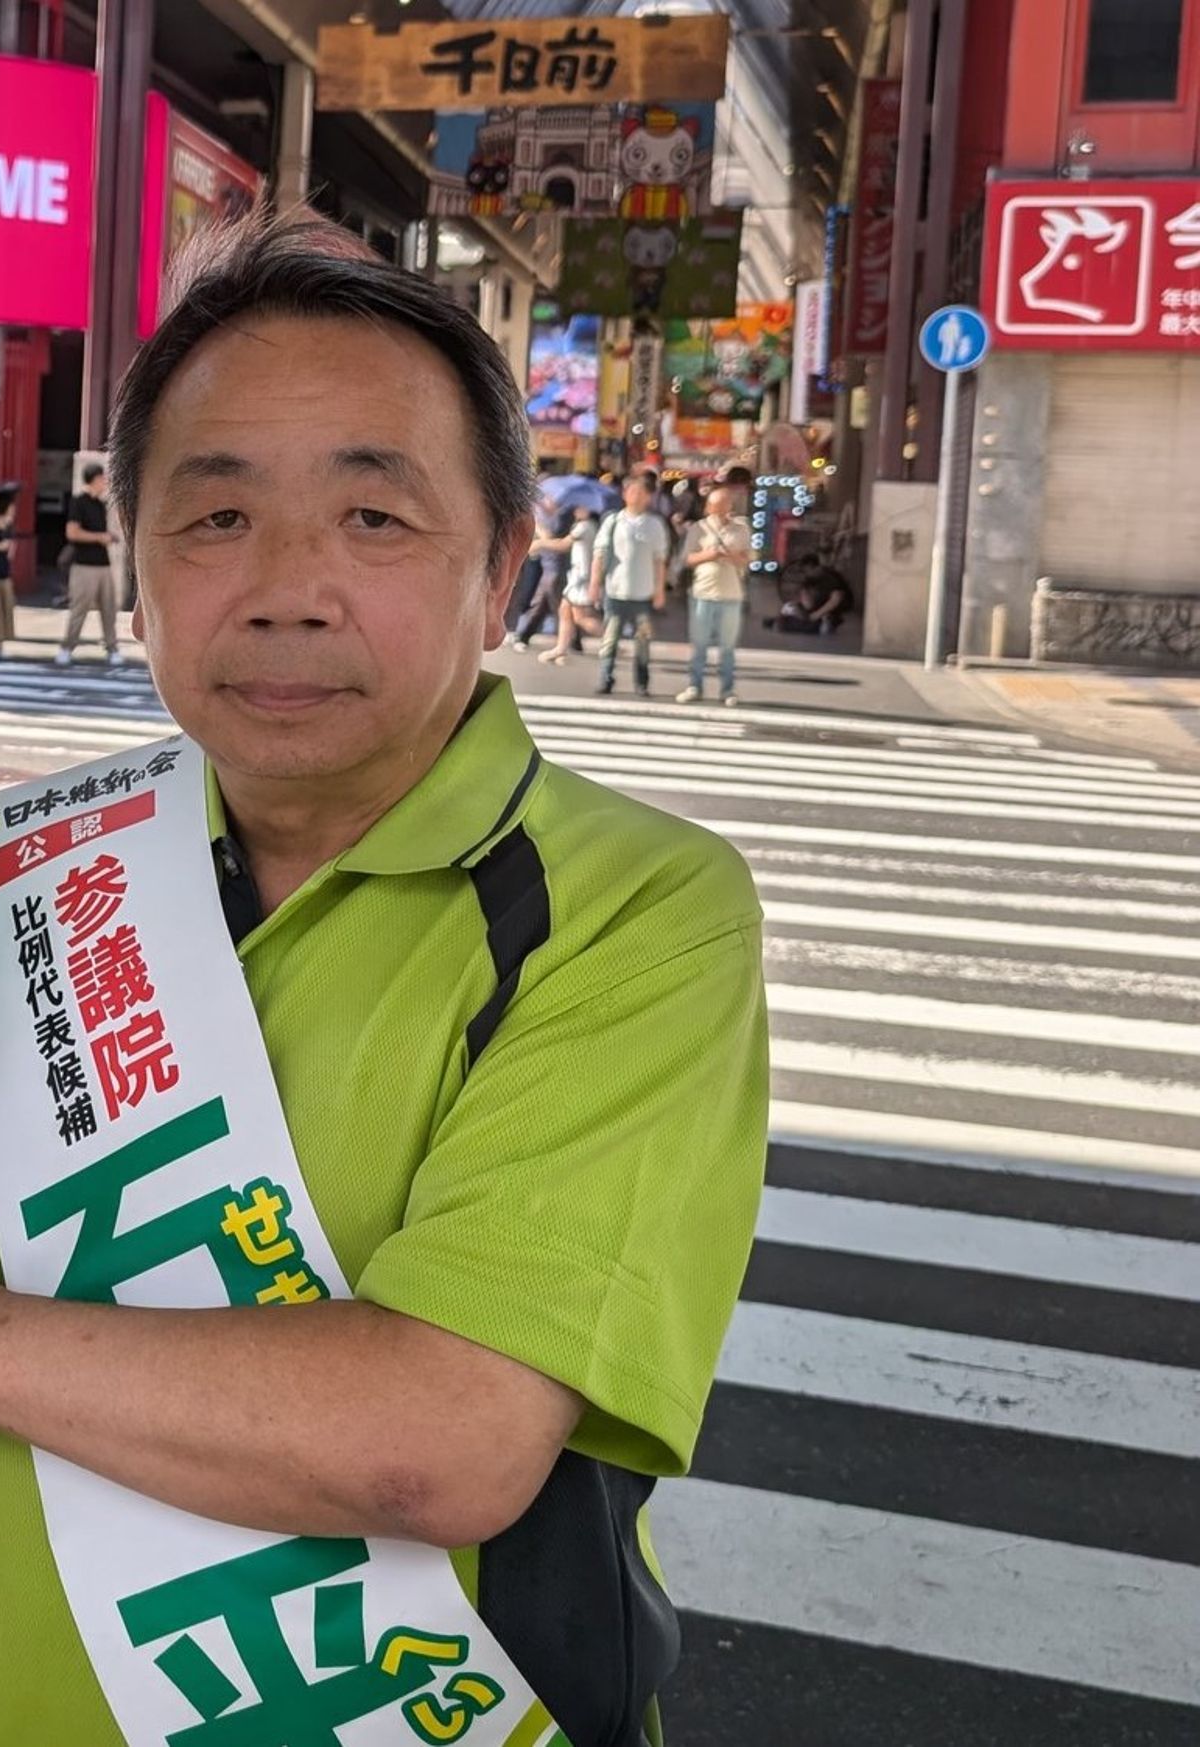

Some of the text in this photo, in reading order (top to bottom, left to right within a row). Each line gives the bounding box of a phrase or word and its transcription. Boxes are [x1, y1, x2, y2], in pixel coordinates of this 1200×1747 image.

[420, 27, 617, 95] 千日前
[3, 750, 183, 828] 日本維新の会
[15, 811, 105, 869] 公認
[10, 895, 99, 1147] 比例代表候補
[53, 854, 180, 1122] 参議院
